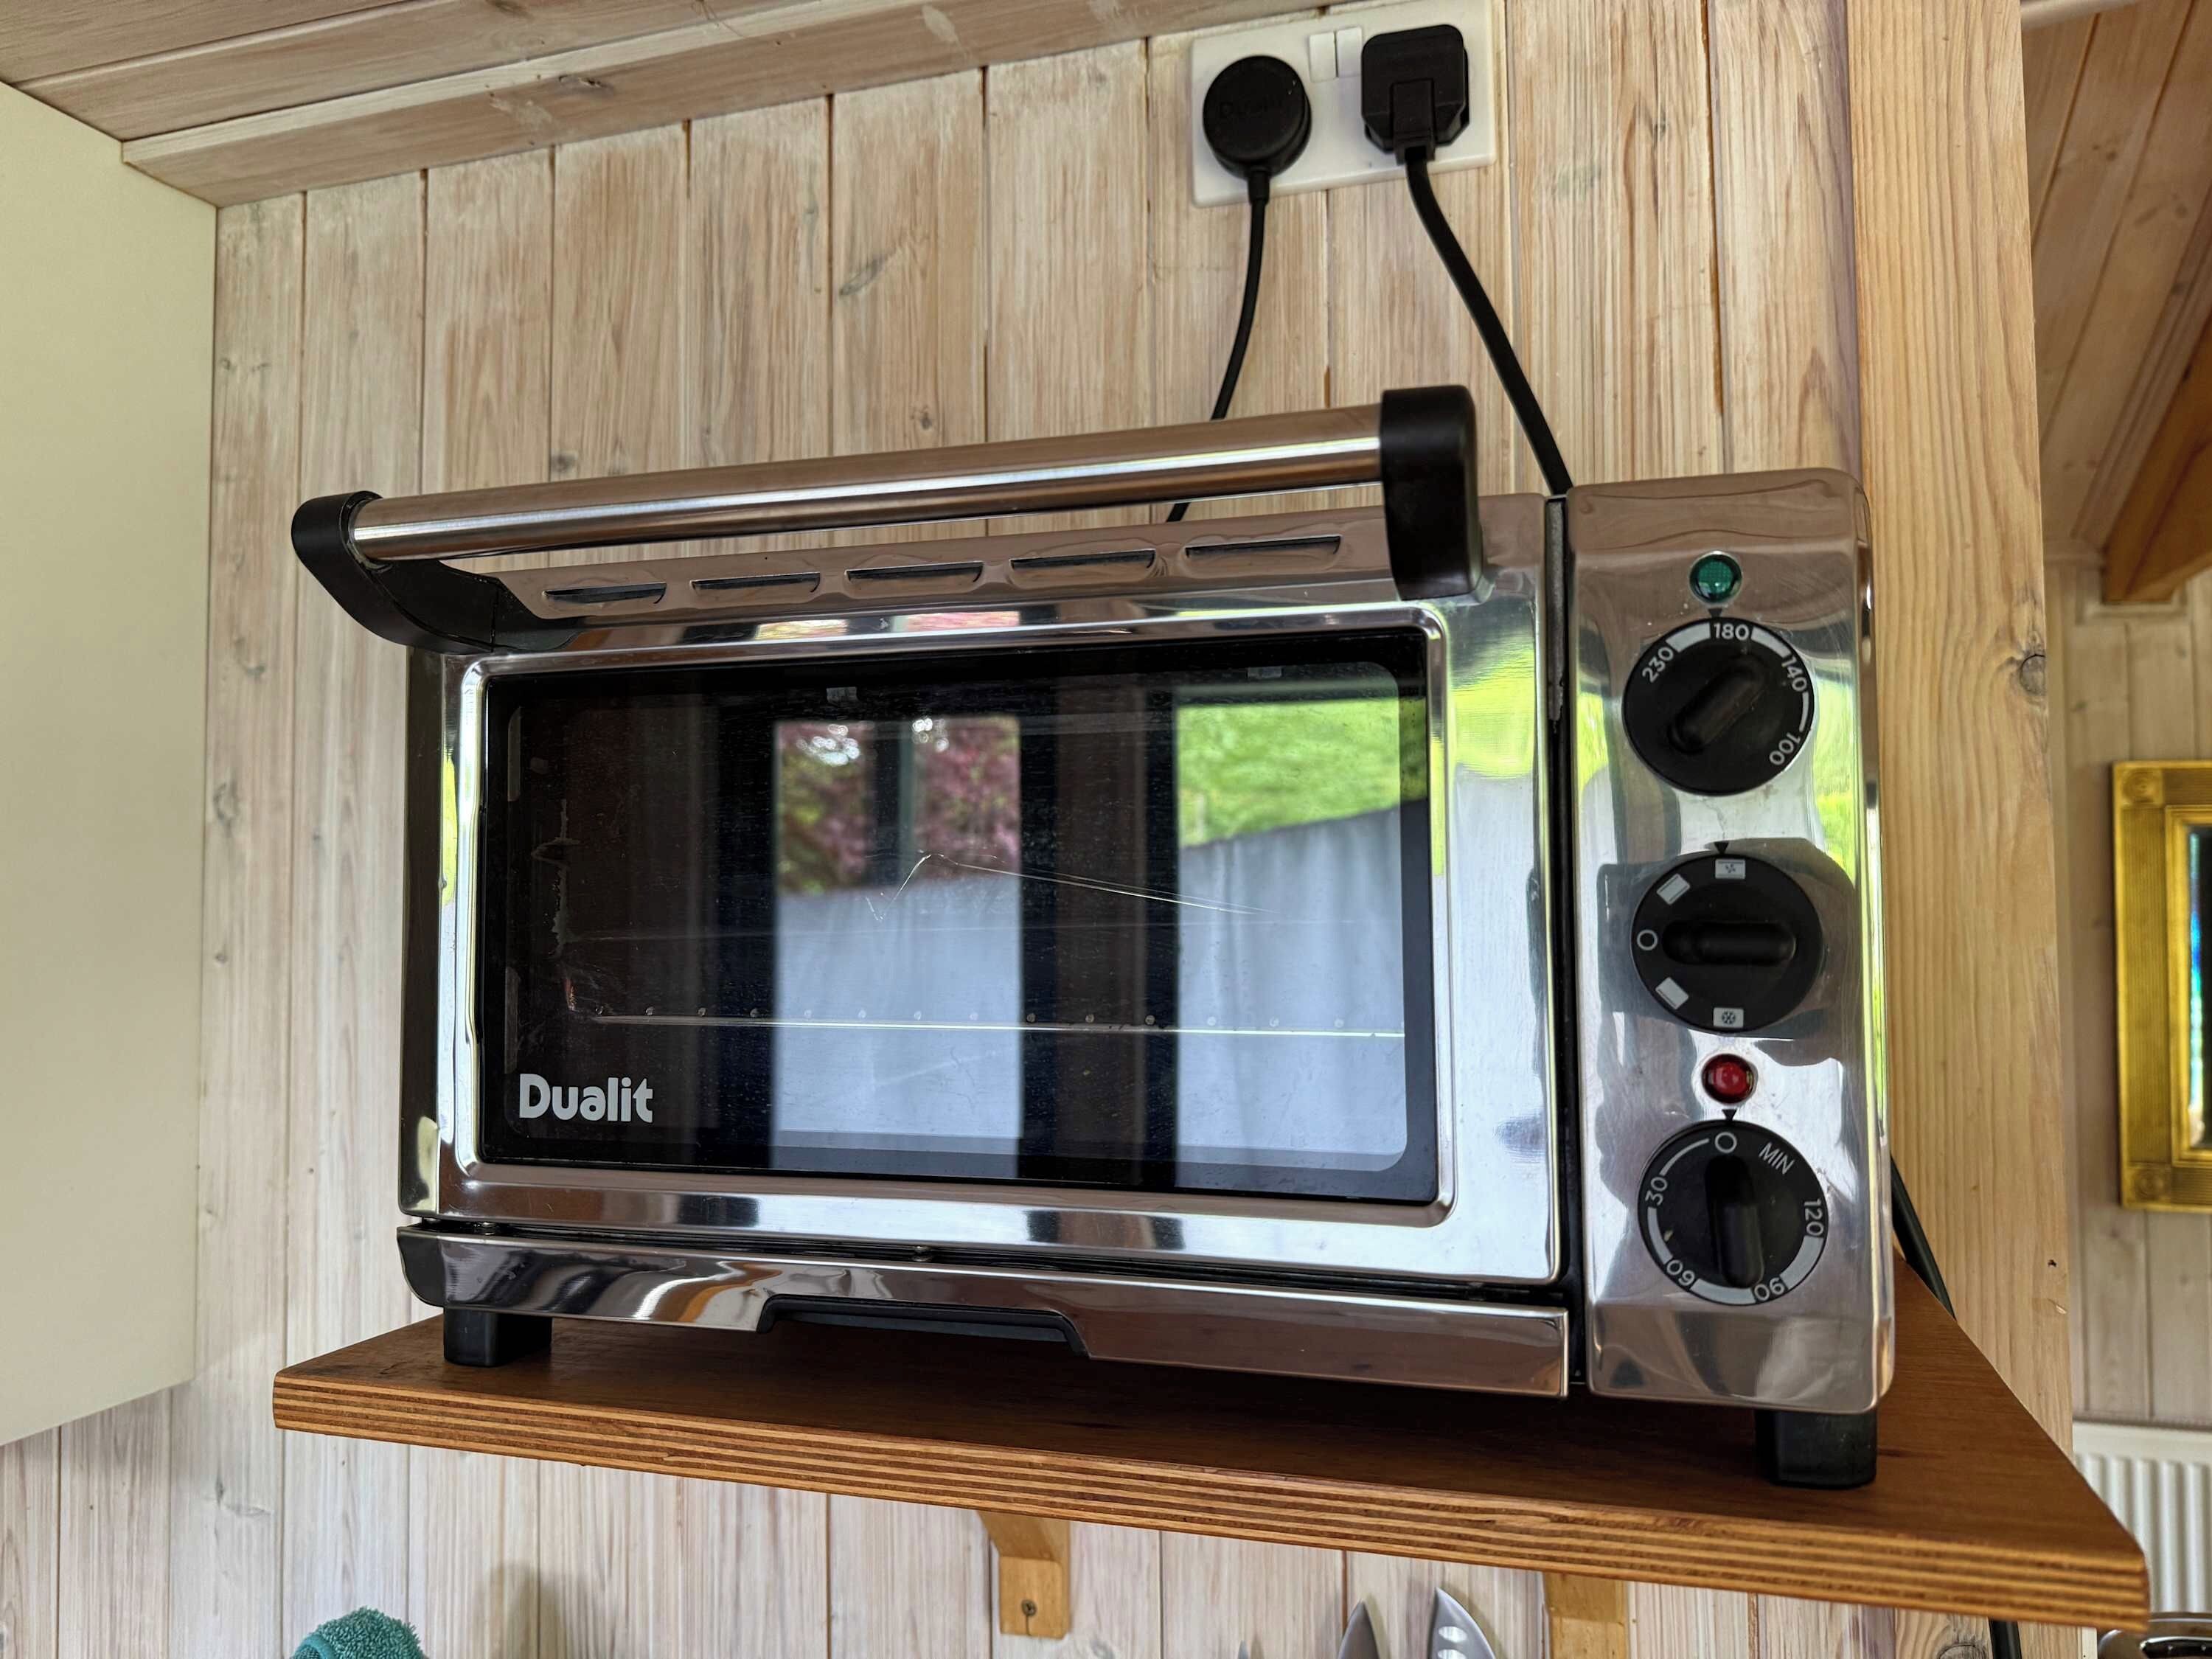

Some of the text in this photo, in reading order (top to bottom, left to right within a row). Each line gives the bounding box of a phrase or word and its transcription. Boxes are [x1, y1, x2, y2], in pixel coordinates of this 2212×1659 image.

[1713, 622, 1750, 640] 180
[1642, 646, 1674, 683] 230
[1781, 654, 1807, 692] 140
[1770, 732, 1801, 765] 100
[519, 1073, 653, 1123] Dualit
[1759, 1142, 1795, 1175] MIN
[1645, 1177, 1668, 1206] 30
[1804, 1198, 1823, 1237] 120
[1666, 1259, 1696, 1287] 60
[1754, 1277, 1785, 1301] 90
